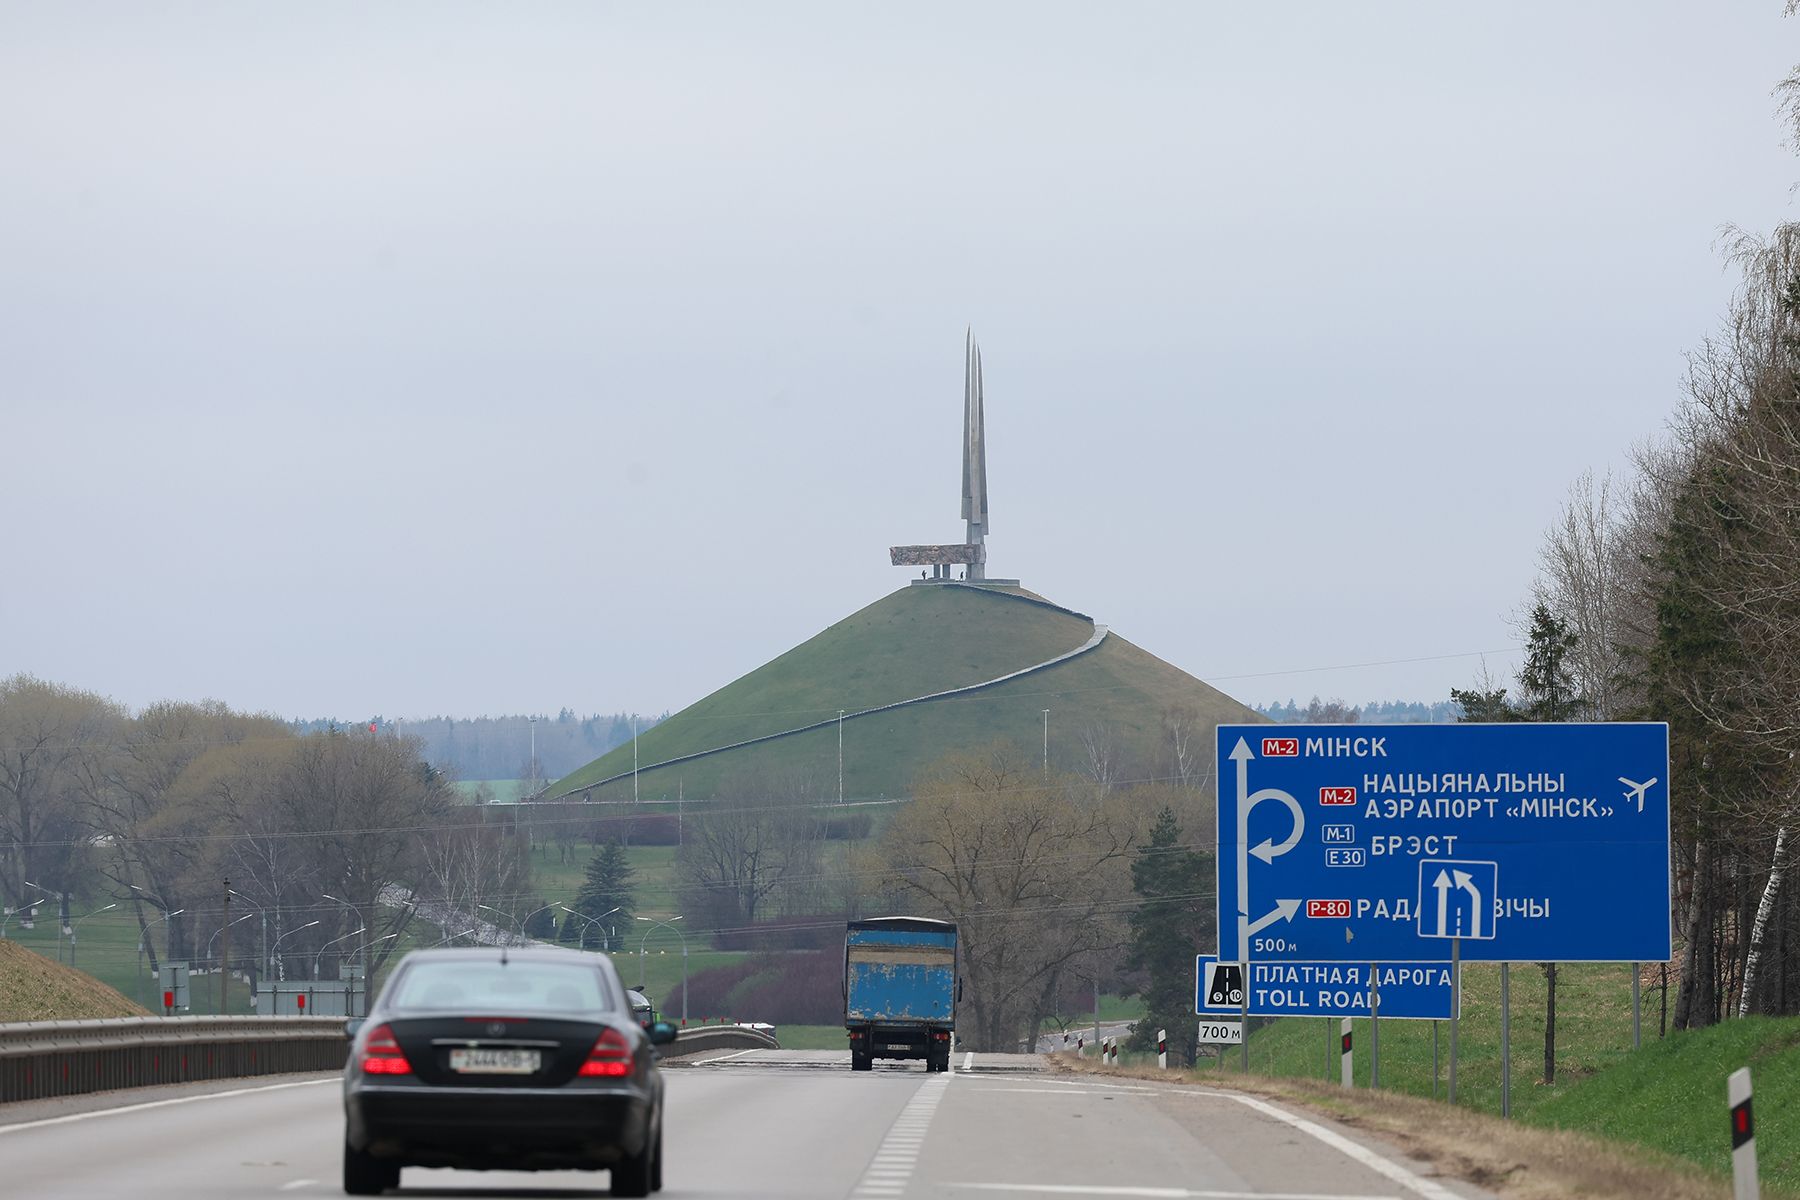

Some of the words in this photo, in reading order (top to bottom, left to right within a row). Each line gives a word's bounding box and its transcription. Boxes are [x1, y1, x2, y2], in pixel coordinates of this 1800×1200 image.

[1266, 740, 1295, 755] М-2
[1305, 737, 1387, 757] МІНСК
[1363, 773, 1565, 797] НАЦЫЯНАЛЬНЫ
[1323, 789, 1353, 803] М-2
[1364, 799, 1499, 818] АЭРАПОРТ
[1505, 798, 1614, 818] «МІНСК»
[1326, 827, 1351, 841] М-1
[1371, 835, 1458, 856] БРЭСТ
[1329, 850, 1339, 865] E
[1342, 850, 1362, 865] 30
[1310, 902, 1347, 916] Р-80
[1255, 938, 1286, 952] 500
[1255, 965, 1359, 985] ПЛАТНАЯ
[1366, 967, 1452, 987] ДАРОГА
[1231, 990, 1242, 1001] 10
[1255, 989, 1310, 1007] TOLL
[1318, 990, 1382, 1008] ROAD
[1202, 1026, 1229, 1039] 700
